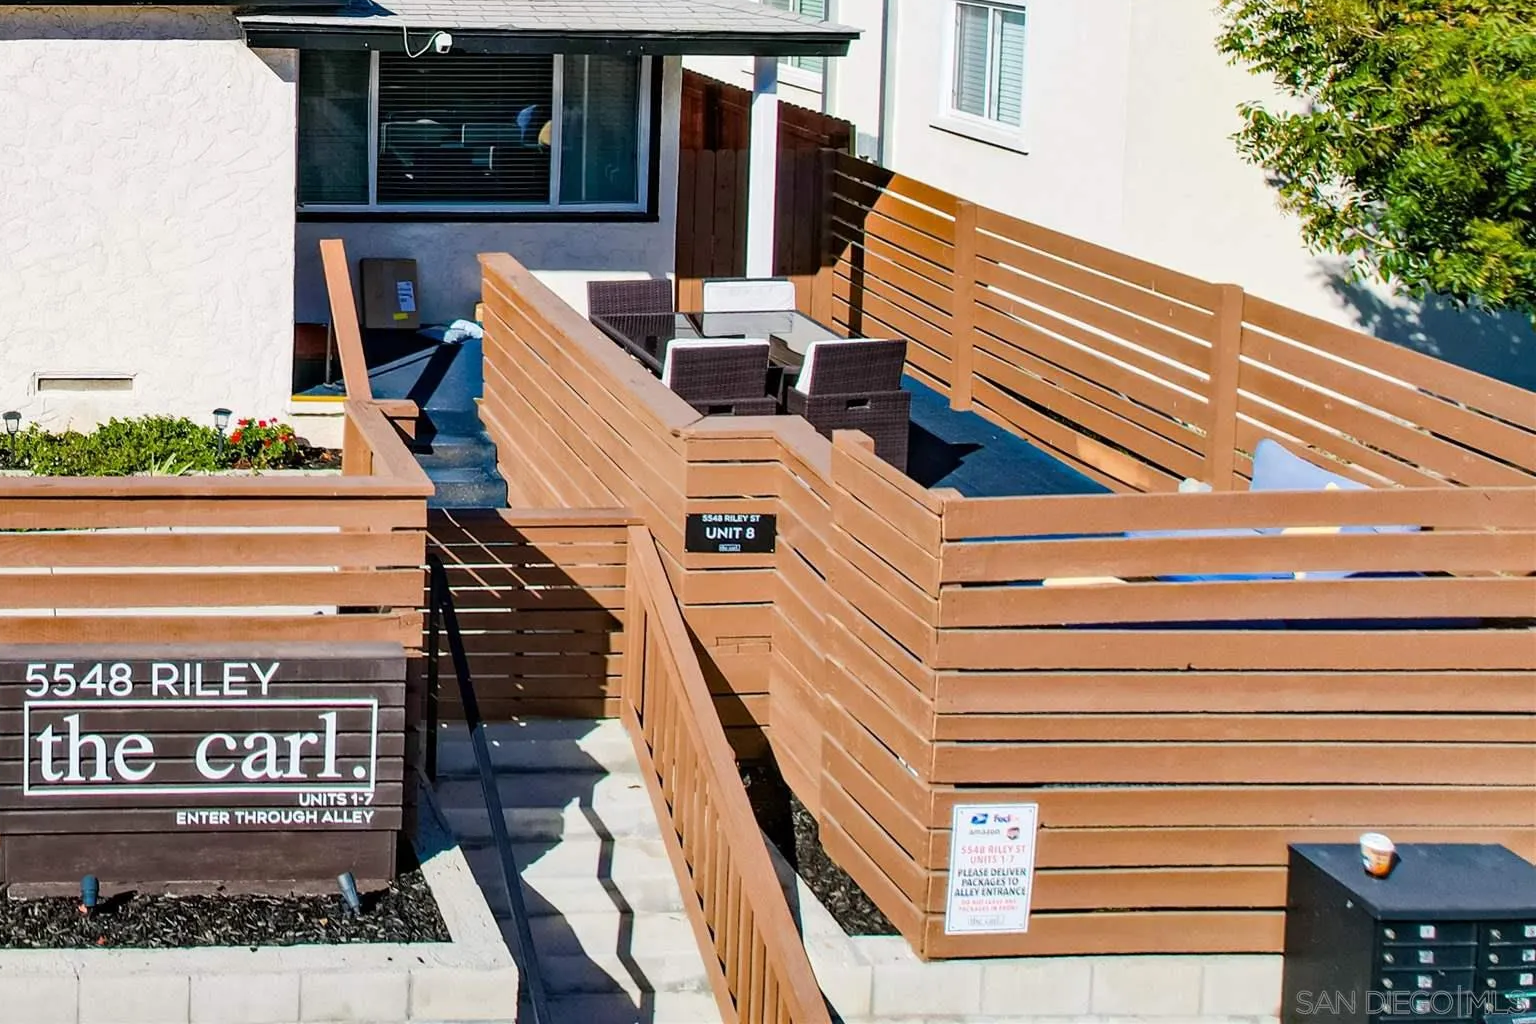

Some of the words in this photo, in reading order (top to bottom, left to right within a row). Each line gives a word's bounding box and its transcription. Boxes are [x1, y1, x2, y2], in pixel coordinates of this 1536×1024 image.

[702, 514, 723, 523] 5548
[724, 514, 749, 523] RILEY
[750, 514, 760, 522] ST
[705, 527, 743, 539] UNIT
[745, 527, 755, 539] 8
[24, 662, 133, 697] 5548
[152, 662, 280, 696] RILEY
[35, 713, 156, 782] the
[195, 711, 366, 780] carl.
[299, 793, 347, 806] UNITS
[350, 792, 374, 805] 1-7
[176, 812, 231, 825] ENTER
[235, 812, 319, 824] THROUGH
[321, 811, 374, 824] ALLEY
[987, 845, 1013, 854] RILEY
[970, 855, 997, 864] UNITS
[957, 868, 988, 877] PLEASE
[990, 867, 1027, 876] DELIVER
[961, 877, 1005, 886] PACKAGES
[1007, 877, 1019, 885] TO
[954, 887, 979, 896] ALLEY
[981, 886, 1026, 896] ENTRANCE
